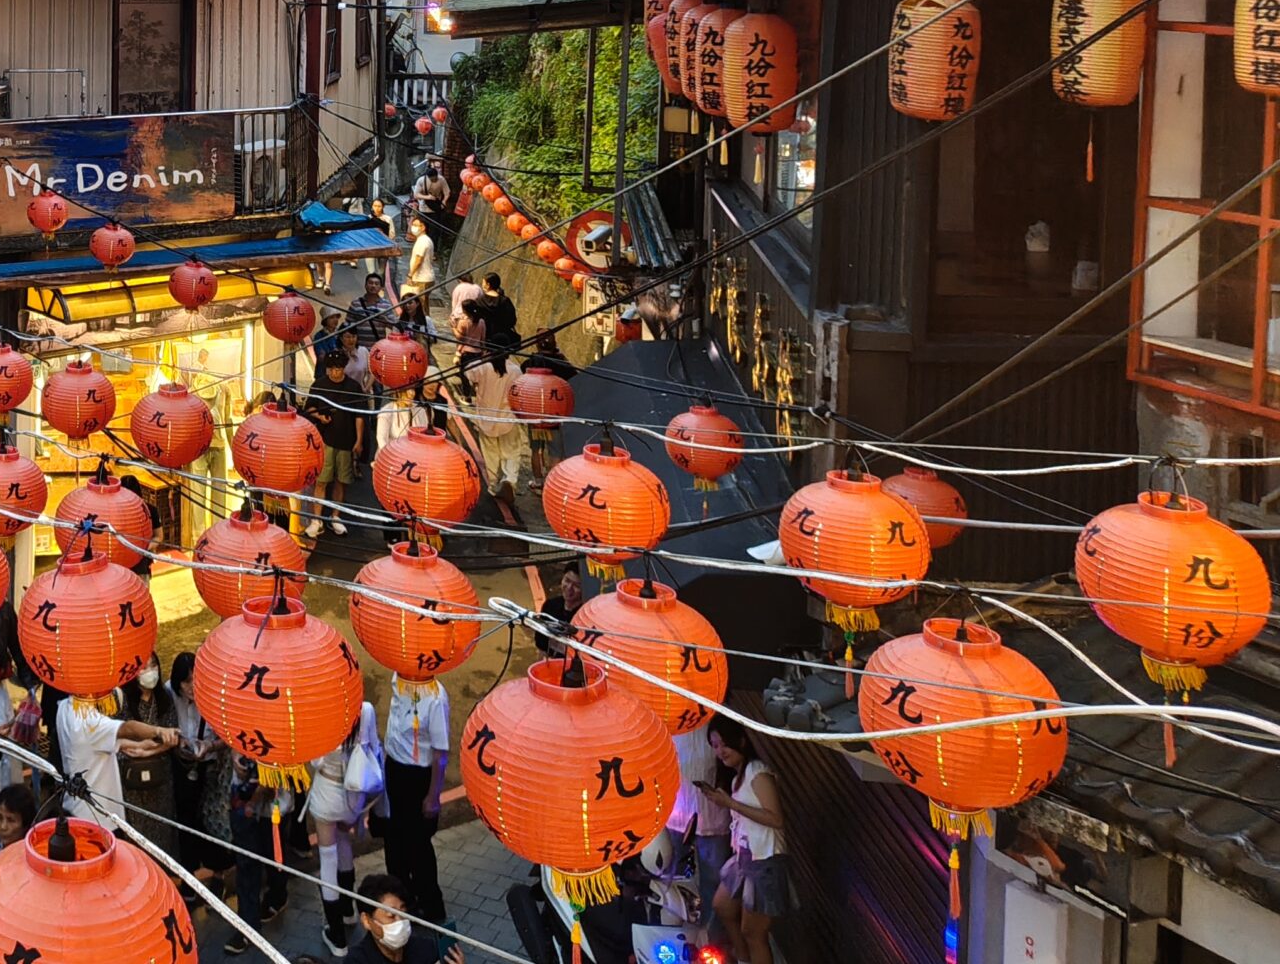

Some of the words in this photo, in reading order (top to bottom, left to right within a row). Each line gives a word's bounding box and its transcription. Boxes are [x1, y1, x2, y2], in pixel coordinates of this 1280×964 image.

[76, 163, 204, 193] Denim
[83, 389, 103, 432] 九份
[146, 410, 168, 458] 九份
[241, 431, 260, 484] 九份
[4, 482, 28, 531] 九份
[31, 600, 58, 682] 九份
[118, 601, 145, 682] 九份
[1179, 555, 1230, 649] 九份
[236, 663, 280, 757] 九份
[882, 679, 924, 785] 九份
[595, 756, 645, 862] 九份
